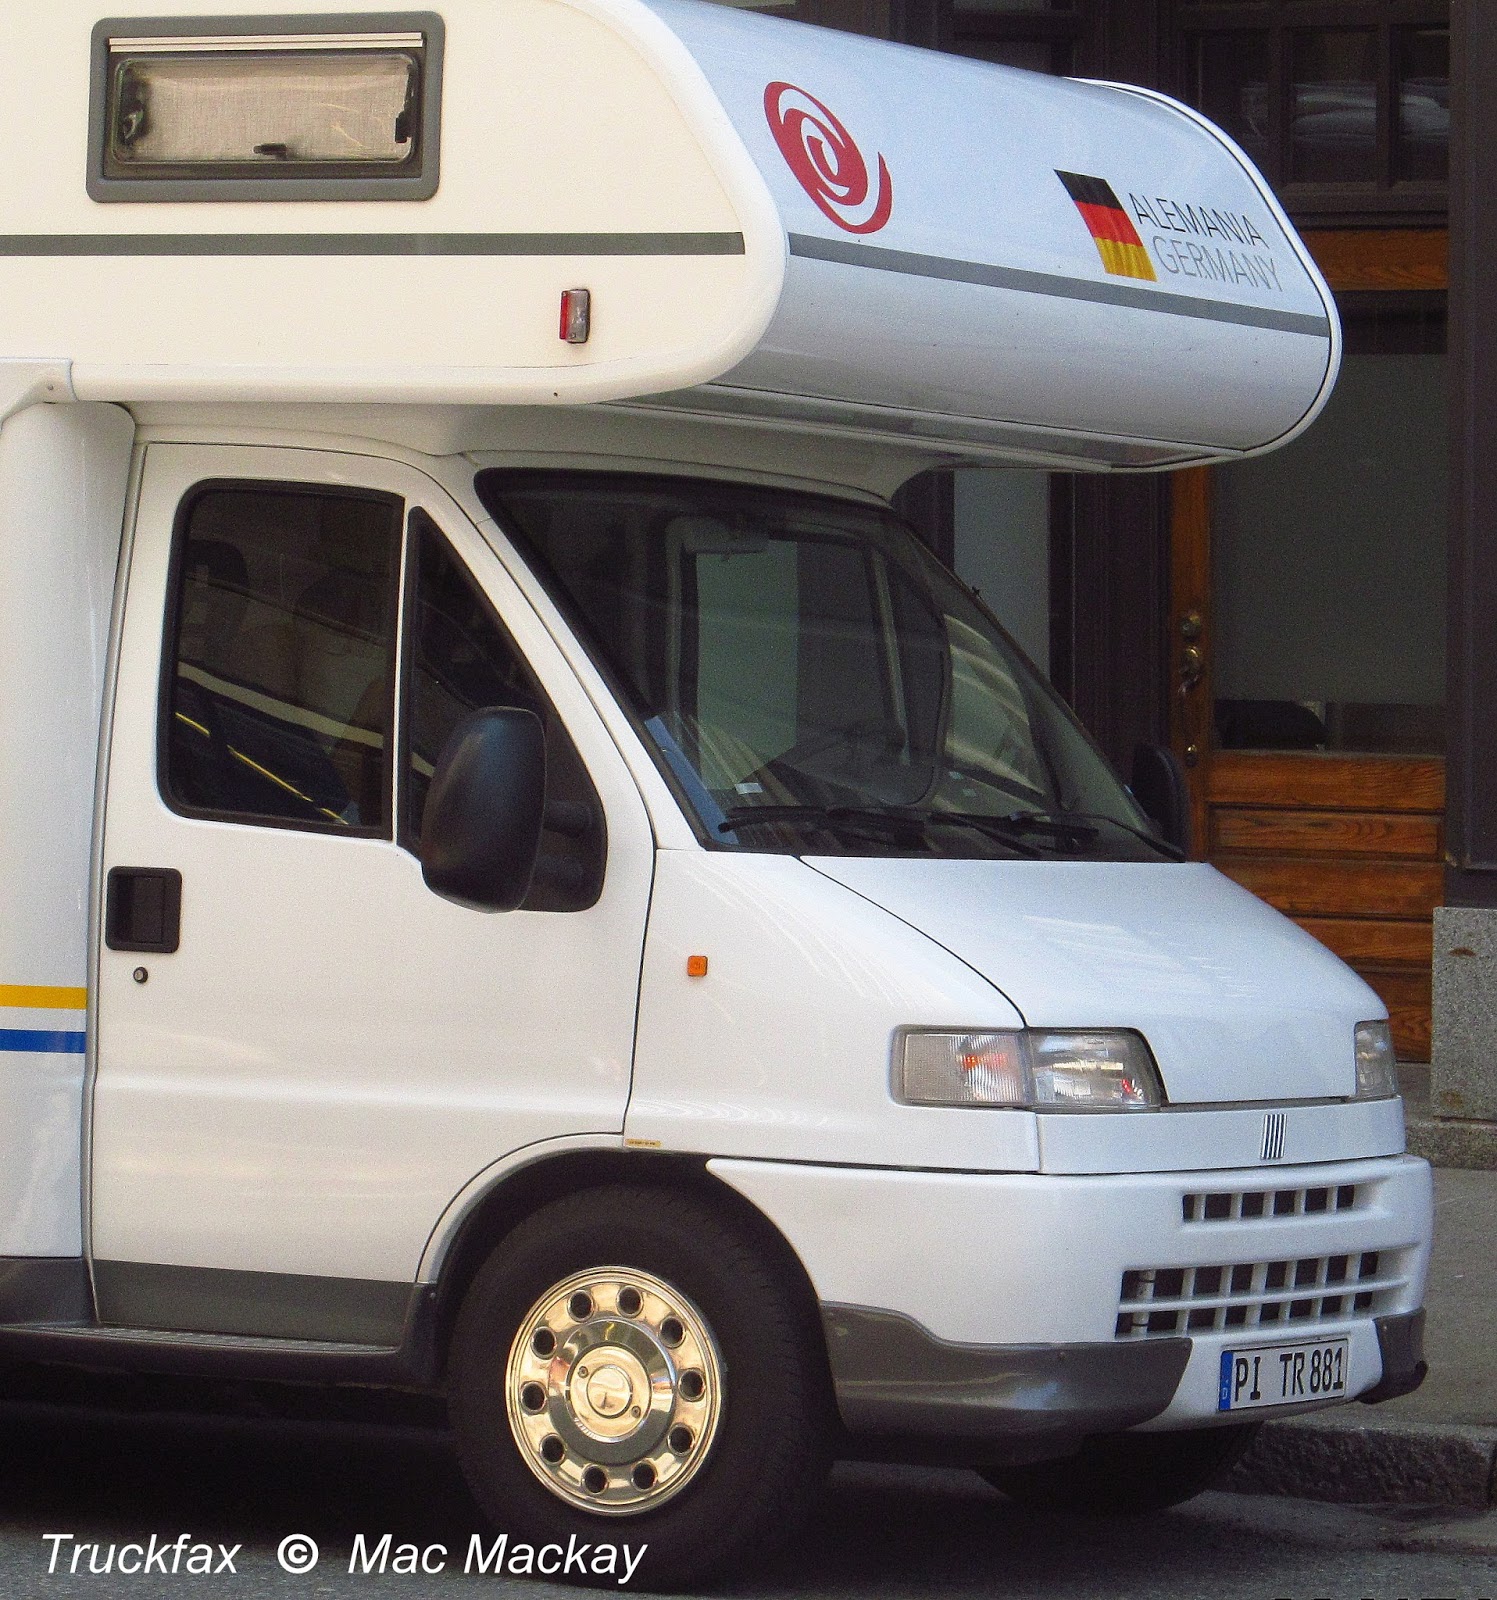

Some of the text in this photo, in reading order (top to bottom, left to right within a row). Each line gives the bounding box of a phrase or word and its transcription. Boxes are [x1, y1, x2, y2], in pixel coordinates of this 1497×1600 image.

[1129, 192, 1270, 250] ALEMANIA
[1152, 235, 1283, 292] GERMANY
[1235, 1346, 1344, 1402] PI TR 881
